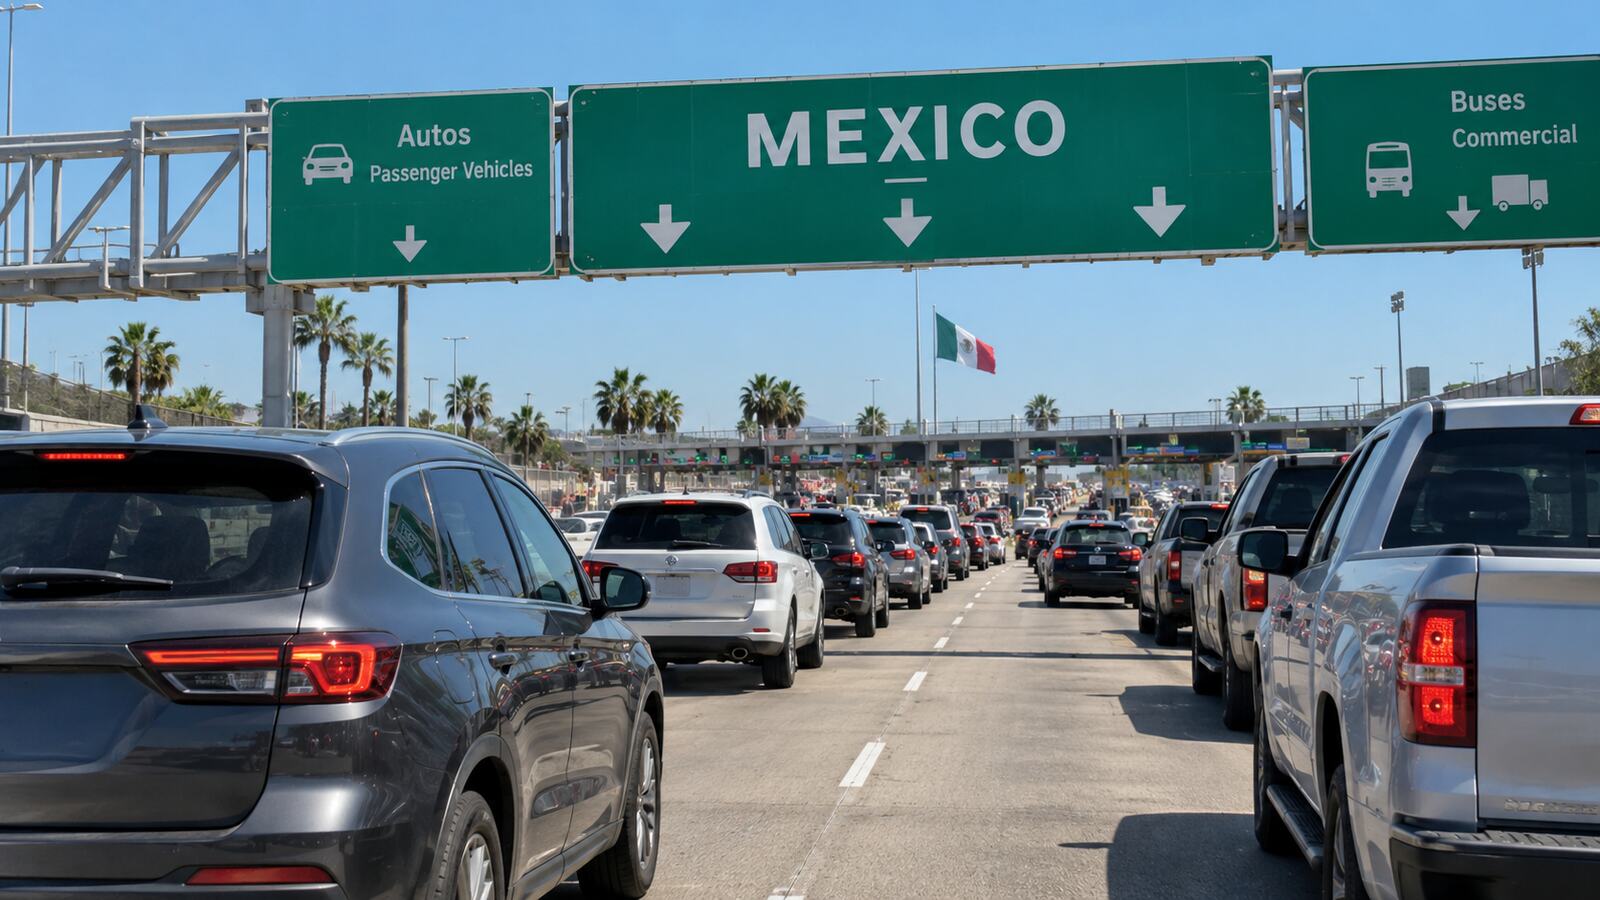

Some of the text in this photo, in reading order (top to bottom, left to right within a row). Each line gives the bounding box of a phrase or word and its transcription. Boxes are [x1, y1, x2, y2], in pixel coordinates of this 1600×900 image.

[1451, 90, 1526, 113] Buses
[397, 124, 471, 148] Autos
[747, 99, 1066, 168] MEXICO
[1452, 123, 1578, 148] Commercial
[370, 159, 533, 185] Passenger Vehicles
